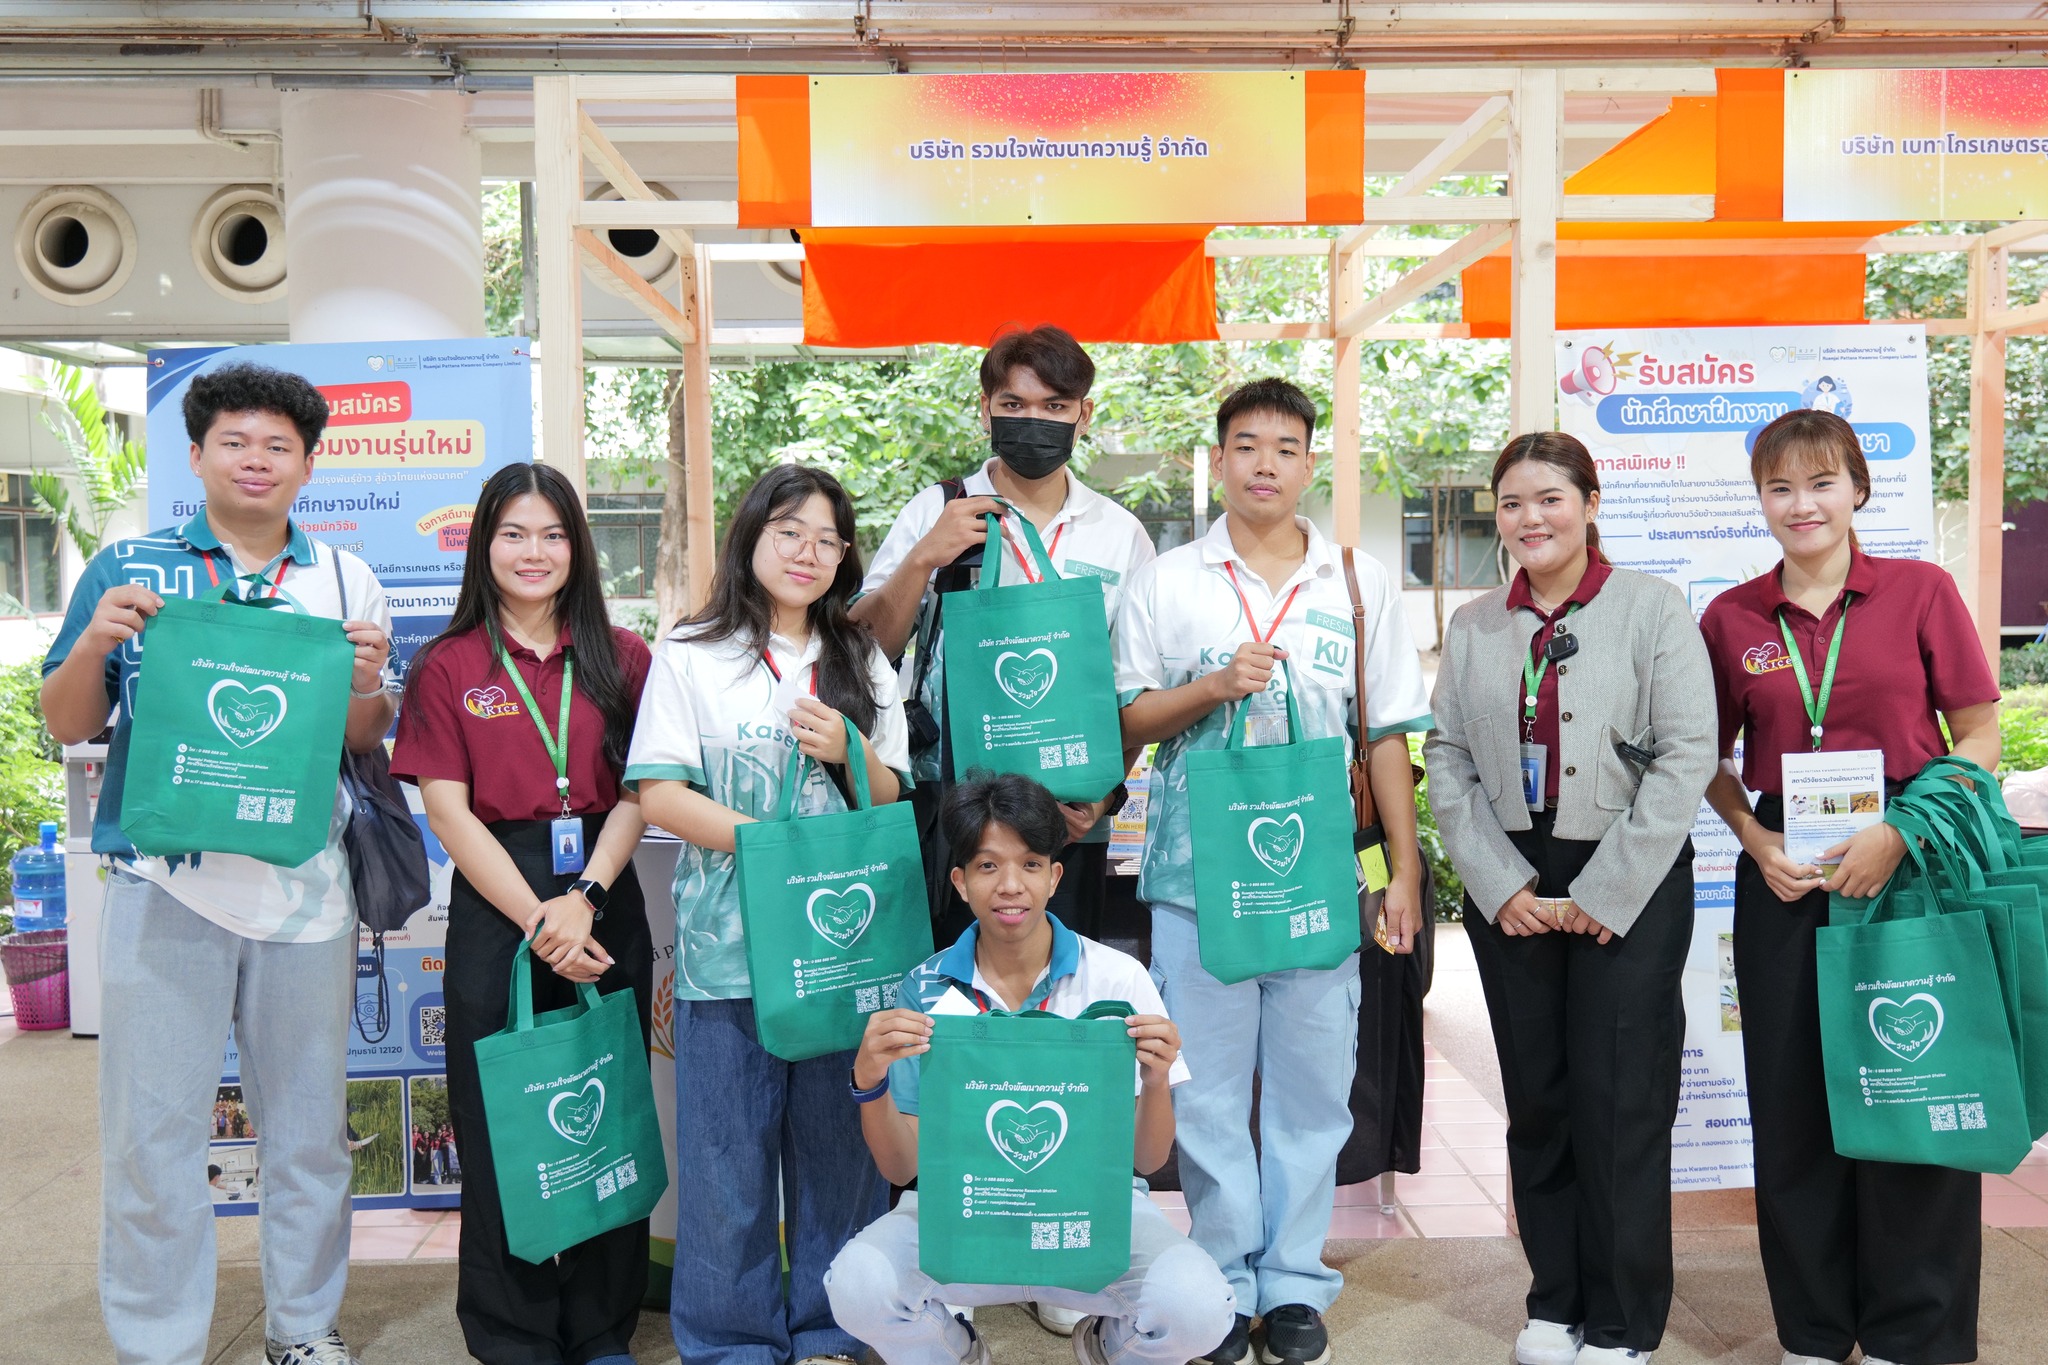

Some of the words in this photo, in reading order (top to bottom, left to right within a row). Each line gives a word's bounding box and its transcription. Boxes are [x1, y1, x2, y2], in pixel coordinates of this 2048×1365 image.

[910, 136, 965, 159] บริษัท
[971, 134, 1153, 163] รวมใจพัฒนาความรู้
[1158, 134, 1209, 158] จำกัด
[1841, 135, 1895, 155] บริษัท
[1903, 133, 2048, 158] เบทาโกรเกษตรอ
[1638, 353, 1756, 386] รับสมัคร
[326, 392, 401, 416] บสมัคร
[1622, 396, 1788, 424] นักศึกษาฝึกงาน
[313, 428, 472, 462] วมงานรุ่นใหม่
[1859, 433, 1890, 452] ษา
[1676, 455, 1686, 470] !!
[306, 474, 372, 486] บปรุงพันธุ์ข้าว
[1870, 472, 1907, 483] กศึกษาที่มี
[172, 500, 207, 517] ยิน
[292, 491, 400, 513] ศึกษาจบใหม่
[1600, 495, 1670, 507] จและรักในการเรียนรู้
[1870, 490, 1904, 498] ศักยภาพ
[297, 519, 357, 533] ช่วยนักวิจัย
[442, 526, 471, 536] พัฒน
[369, 563, 440, 574] นโลยีการเกษตร
[1075, 563, 1114, 581] FRESHY
[1316, 614, 1355, 637] FRESHY
[1315, 636, 1349, 668] KU
[191, 657, 214, 669] บริษัท
[216, 662, 290, 682] รวมใจพัฒนาความรู้
[290, 671, 311, 682] จำกัด
[786, 874, 806, 885] บริษัท
[870, 862, 888, 873] จำกัด
[229, 1052, 238, 1060] 17
[379, 1046, 403, 1054] 12120
[1694, 1067, 1709, 1075] บาท
[964, 1080, 988, 1091] บริษัท
[989, 1080, 1066, 1095] รวมใจพัฒนาความรู้
[1067, 1082, 1089, 1093] จำกัด
